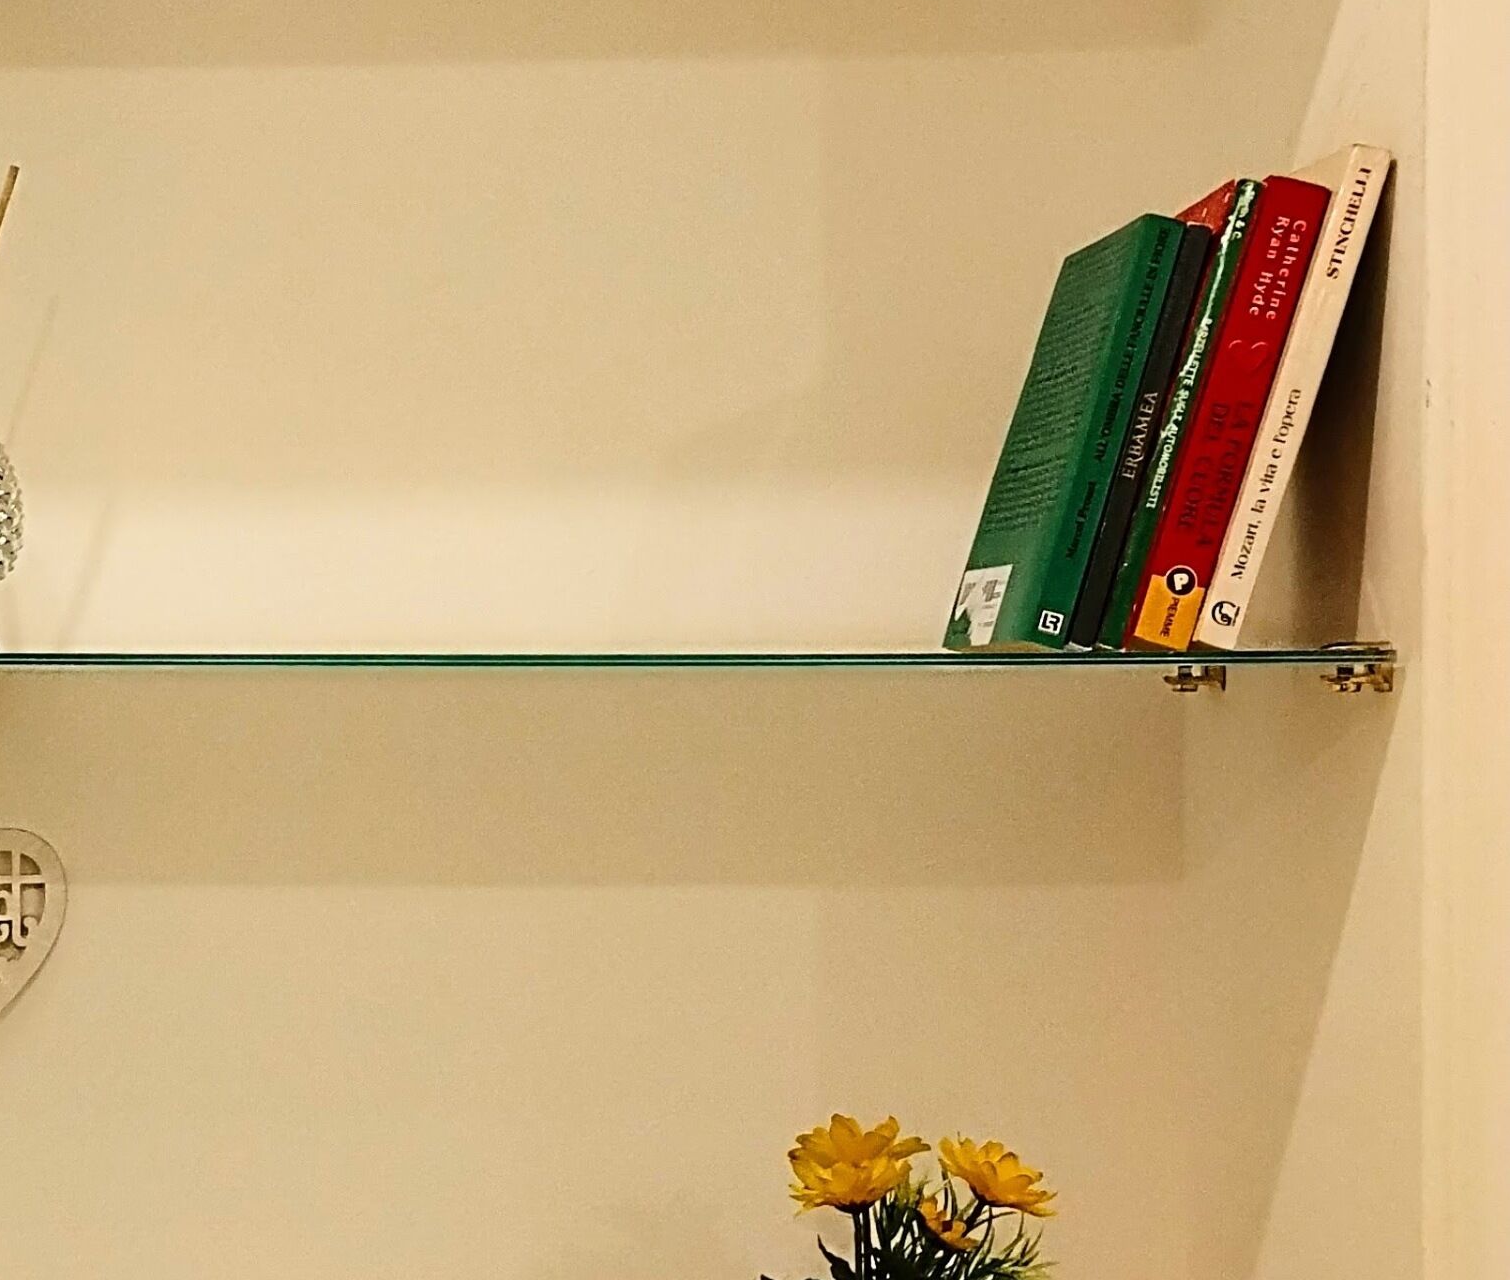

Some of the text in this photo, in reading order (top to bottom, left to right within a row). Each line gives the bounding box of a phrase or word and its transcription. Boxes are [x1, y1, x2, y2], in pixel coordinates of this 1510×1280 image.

[1249, 215, 1291, 317] Ryan Hyde
[1266, 219, 1308, 320] Catherine
[1324, 166, 1373, 281] STINCHELLI
[1121, 391, 1158, 480] ERBAMEA
[1231, 387, 1303, 580] Mozart, la vita e l'opera
[1160, 596, 1181, 638] PIEMME
